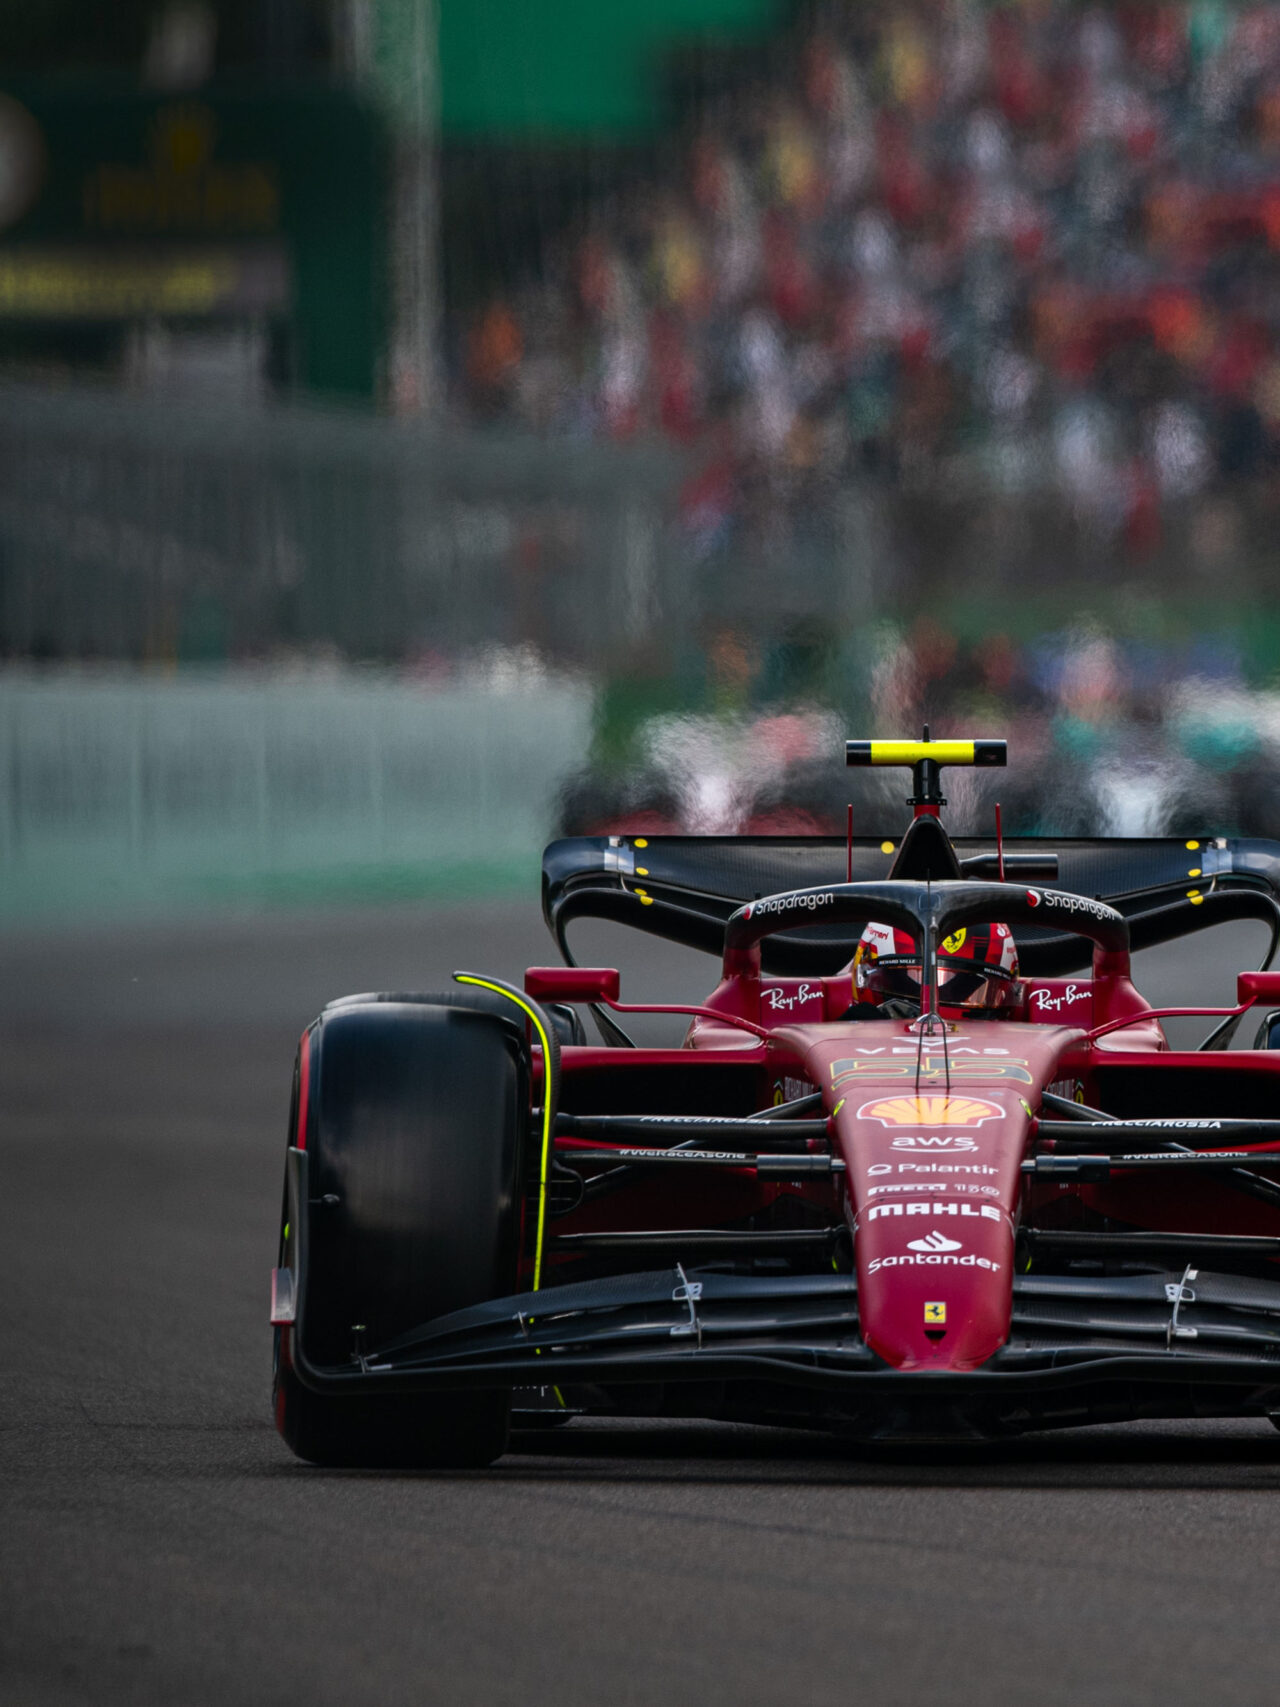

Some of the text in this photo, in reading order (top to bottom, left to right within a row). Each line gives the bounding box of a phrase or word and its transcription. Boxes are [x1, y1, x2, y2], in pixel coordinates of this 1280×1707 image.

[755, 892, 835, 915] Snapdragon
[1043, 891, 1116, 921] Snapdragon
[760, 983, 825, 1010] Ray-Ban
[1029, 984, 1092, 1011] Ray-Ban
[855, 1047, 1010, 1056] VELAS
[830, 1057, 1034, 1092] 55
[891, 1136, 976, 1148] aws
[898, 1162, 1000, 1175] Palantir
[868, 1202, 1001, 1222] MAHLE
[867, 1253, 1001, 1276] Santander
